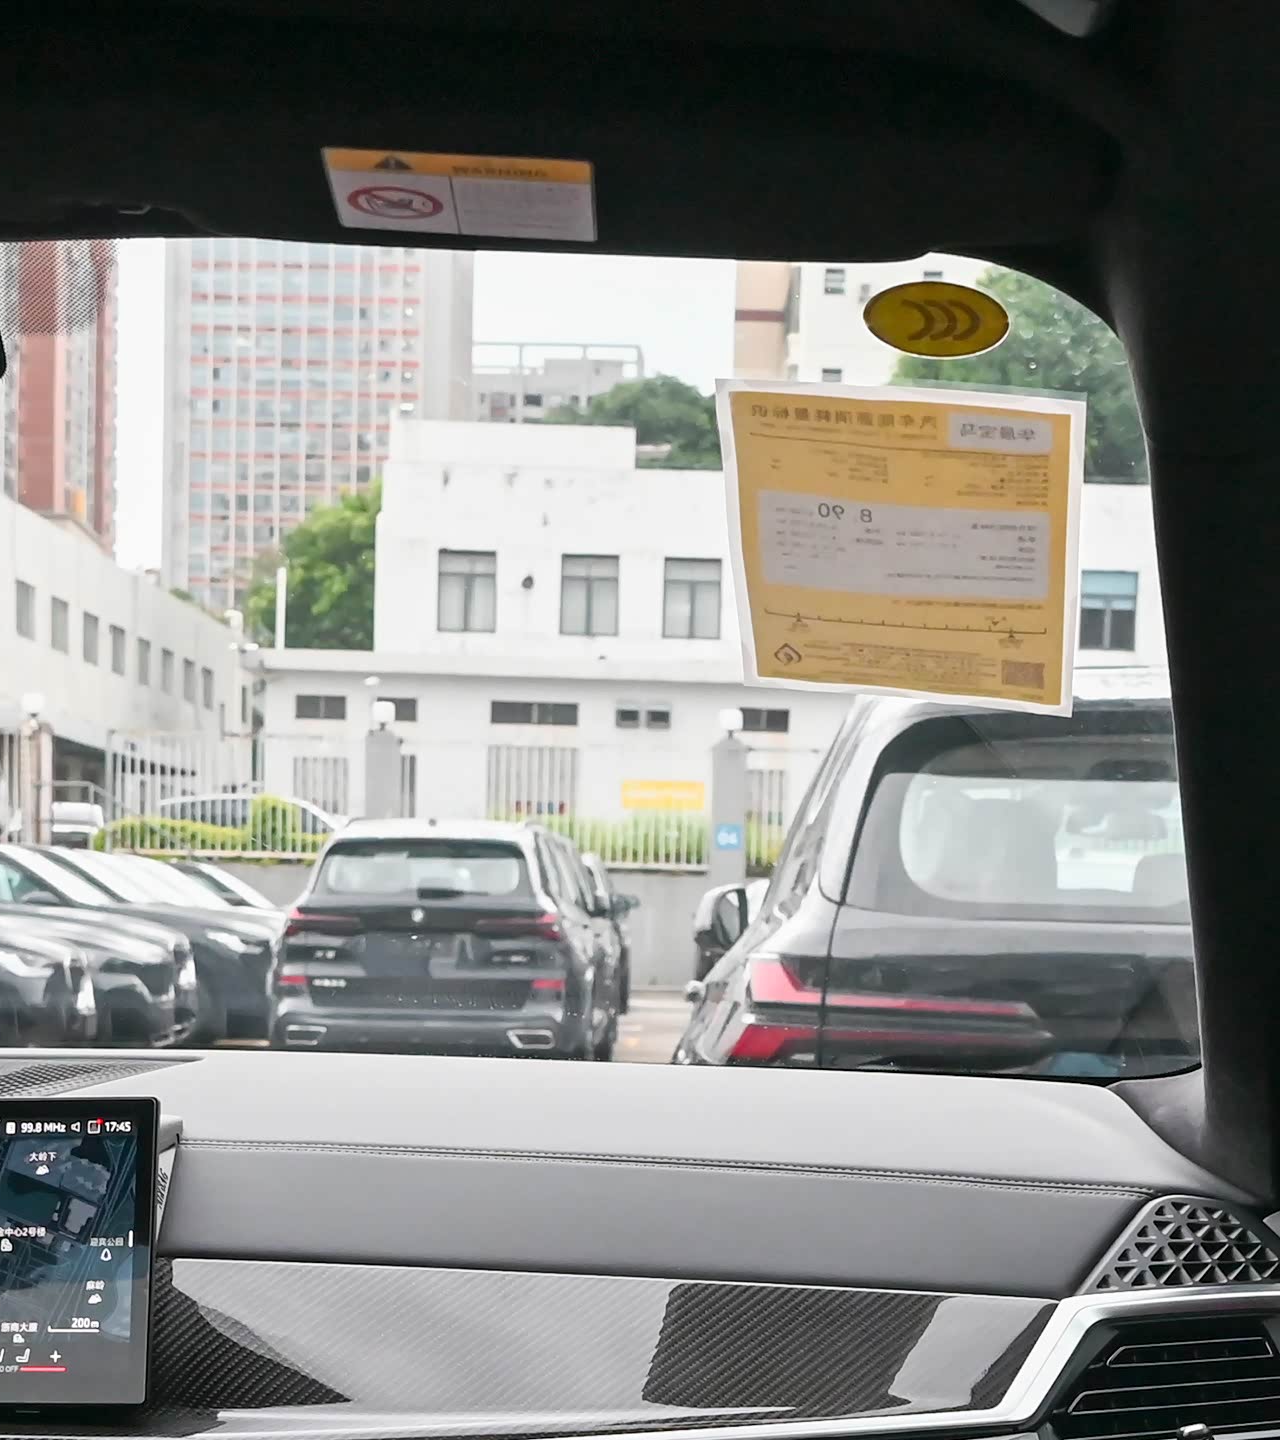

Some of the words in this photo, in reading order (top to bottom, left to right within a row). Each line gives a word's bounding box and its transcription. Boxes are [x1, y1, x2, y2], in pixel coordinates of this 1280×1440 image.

[21, 1122, 42, 1133] 99.8
[43, 1122, 66, 1133] MHz
[104, 1121, 132, 1132] 17:45
[5, 1365, 19, 1373] OFF
